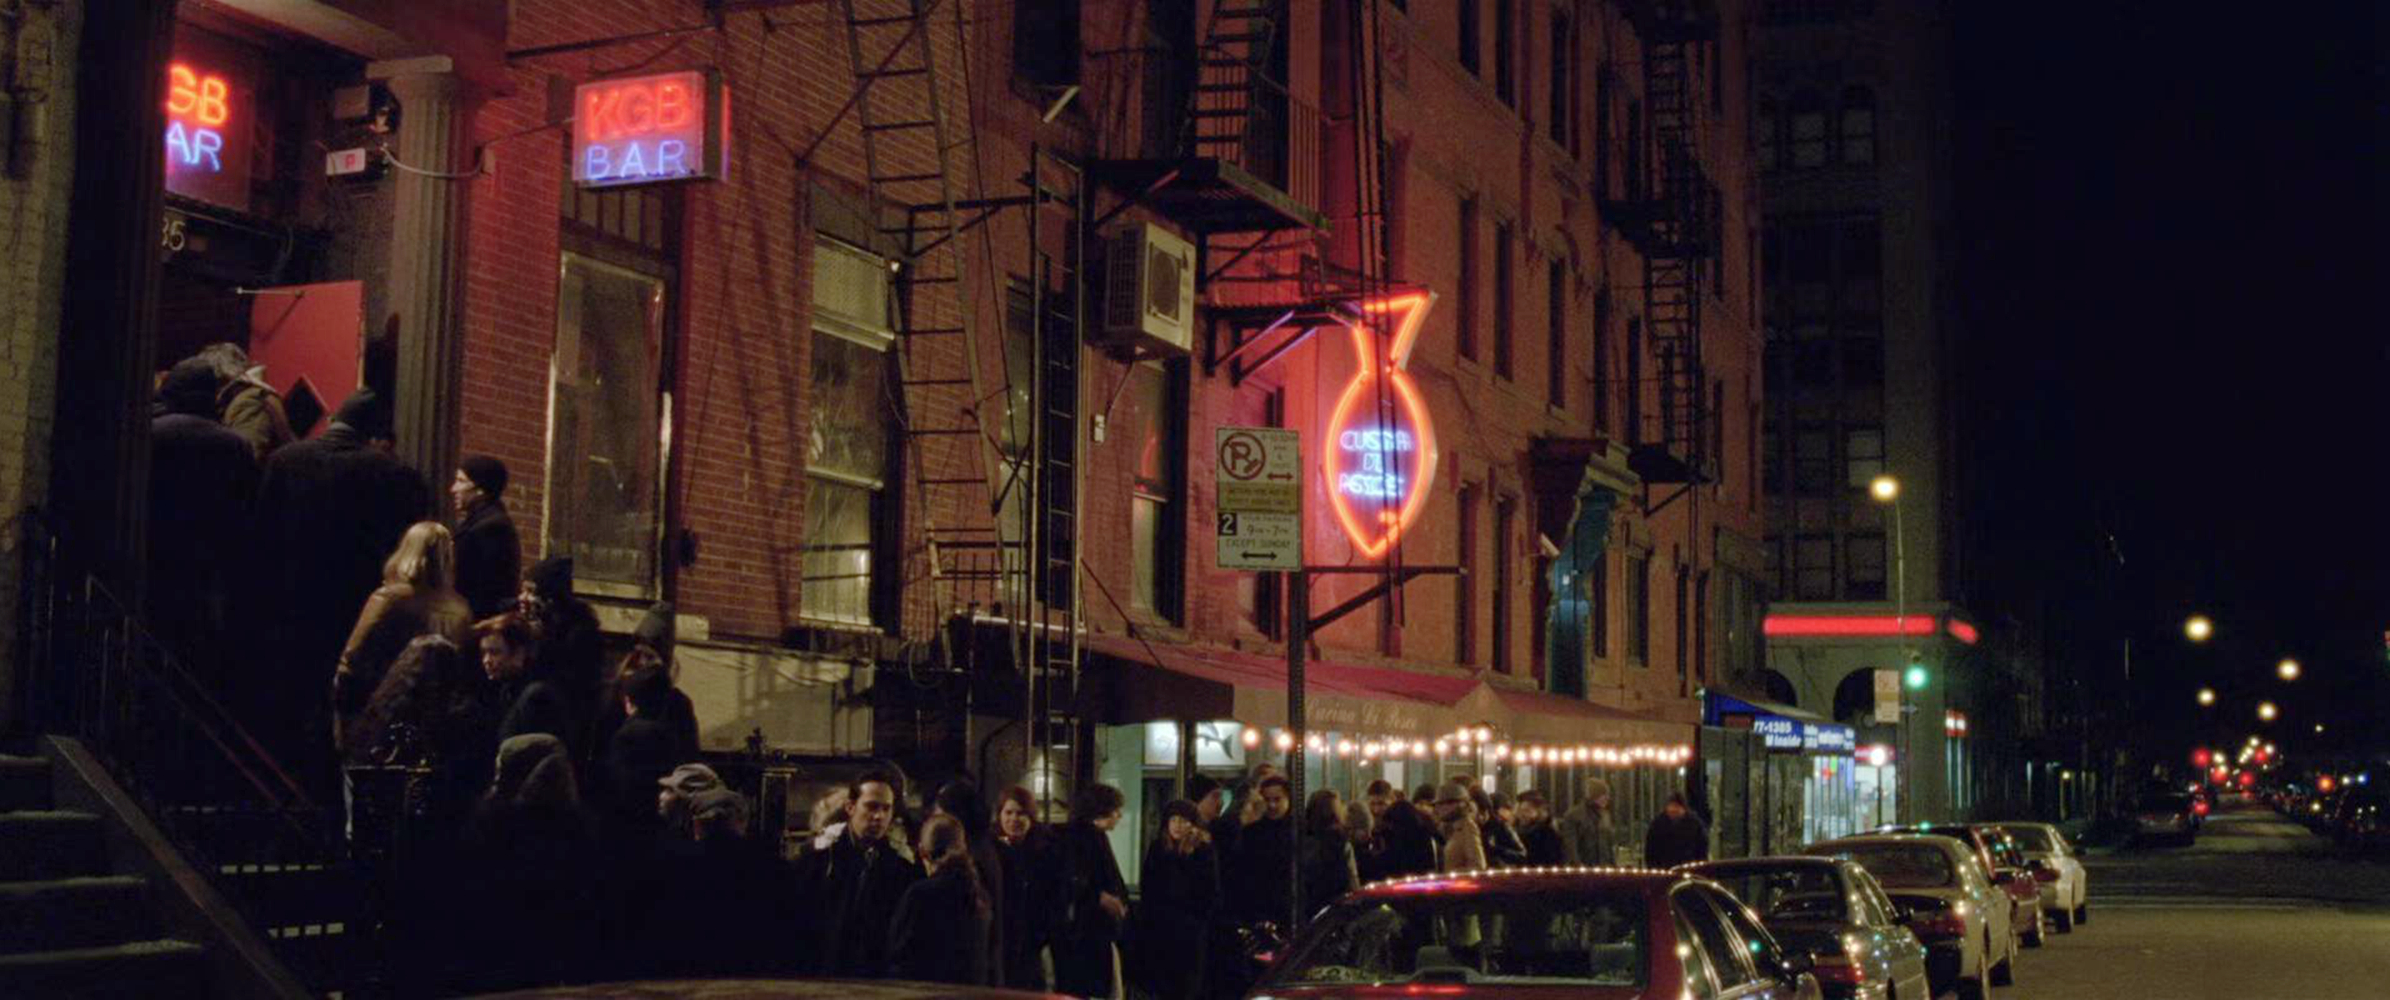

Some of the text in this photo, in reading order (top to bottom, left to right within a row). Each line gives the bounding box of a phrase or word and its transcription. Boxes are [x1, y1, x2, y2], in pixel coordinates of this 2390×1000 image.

[584, 80, 689, 140] KGB
[587, 139, 686, 180] BAR
[1222, 514, 1233, 534] 2
